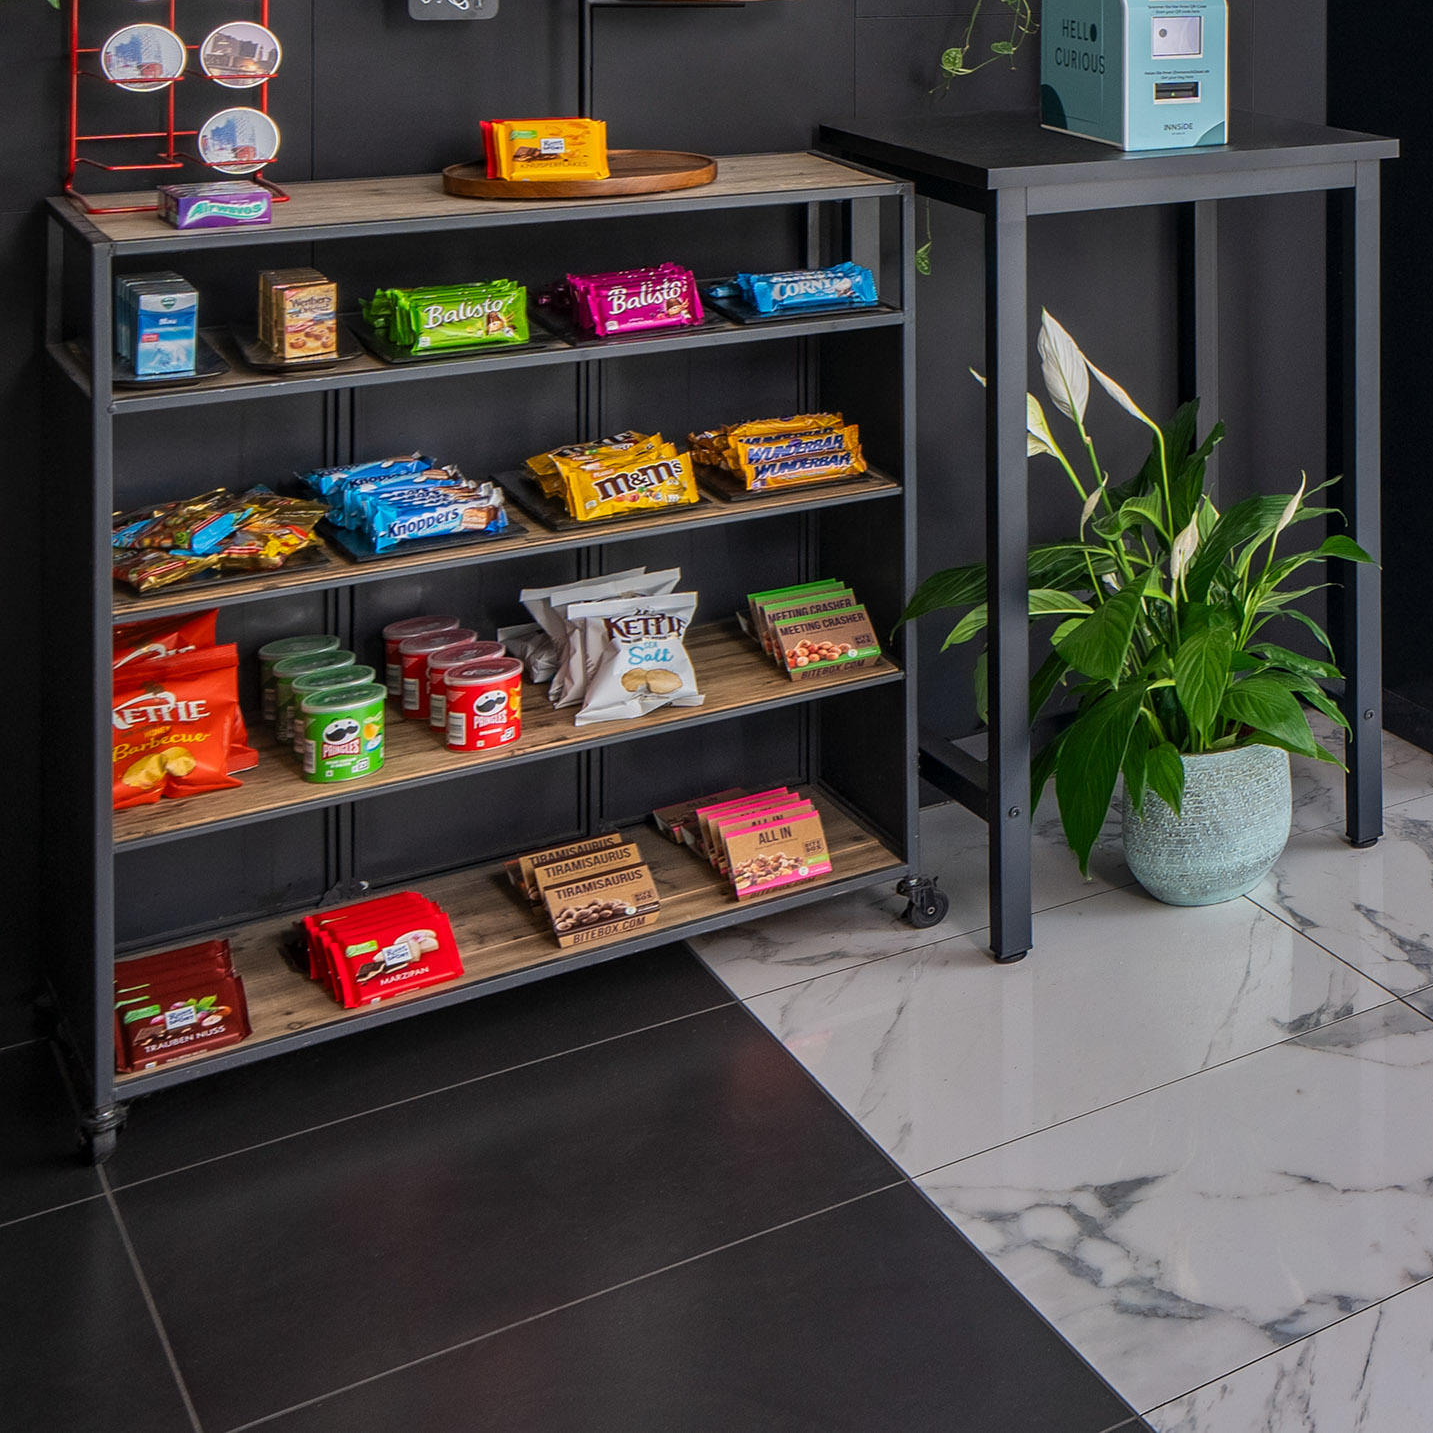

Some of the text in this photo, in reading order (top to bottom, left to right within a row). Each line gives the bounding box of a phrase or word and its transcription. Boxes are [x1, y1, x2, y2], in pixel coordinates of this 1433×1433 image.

[1061, 18, 1097, 43] HELLO
[1054, 46, 1106, 76] CURIOUS
[188, 200, 265, 219] Airwaves
[608, 283, 682, 316] Balisto
[771, 278, 836, 301] CORNY
[423, 298, 504, 329] Balisto
[747, 434, 845, 465] WUNDERBAR
[593, 458, 684, 502] m&m's
[752, 451, 852, 480] WUNDERBAR
[386, 507, 460, 539] Knoppers
[779, 612, 866, 637] MEETING CRASHER
[627, 646, 674, 665] Salt
[473, 709, 507, 729] PRINGLES
[113, 732, 210, 763] Barbecue
[322, 739, 361, 759] PRINGLES
[758, 825, 792, 845] ALL IN
[544, 847, 632, 878] TIRAMISAURUS
[555, 869, 644, 900] TIRAMISAURUS
[573, 916, 646, 944] BITEBOX.COM
[379, 966, 430, 986] MARZIPAN
[145, 1025, 227, 1054] TRAUBEN NUSS
